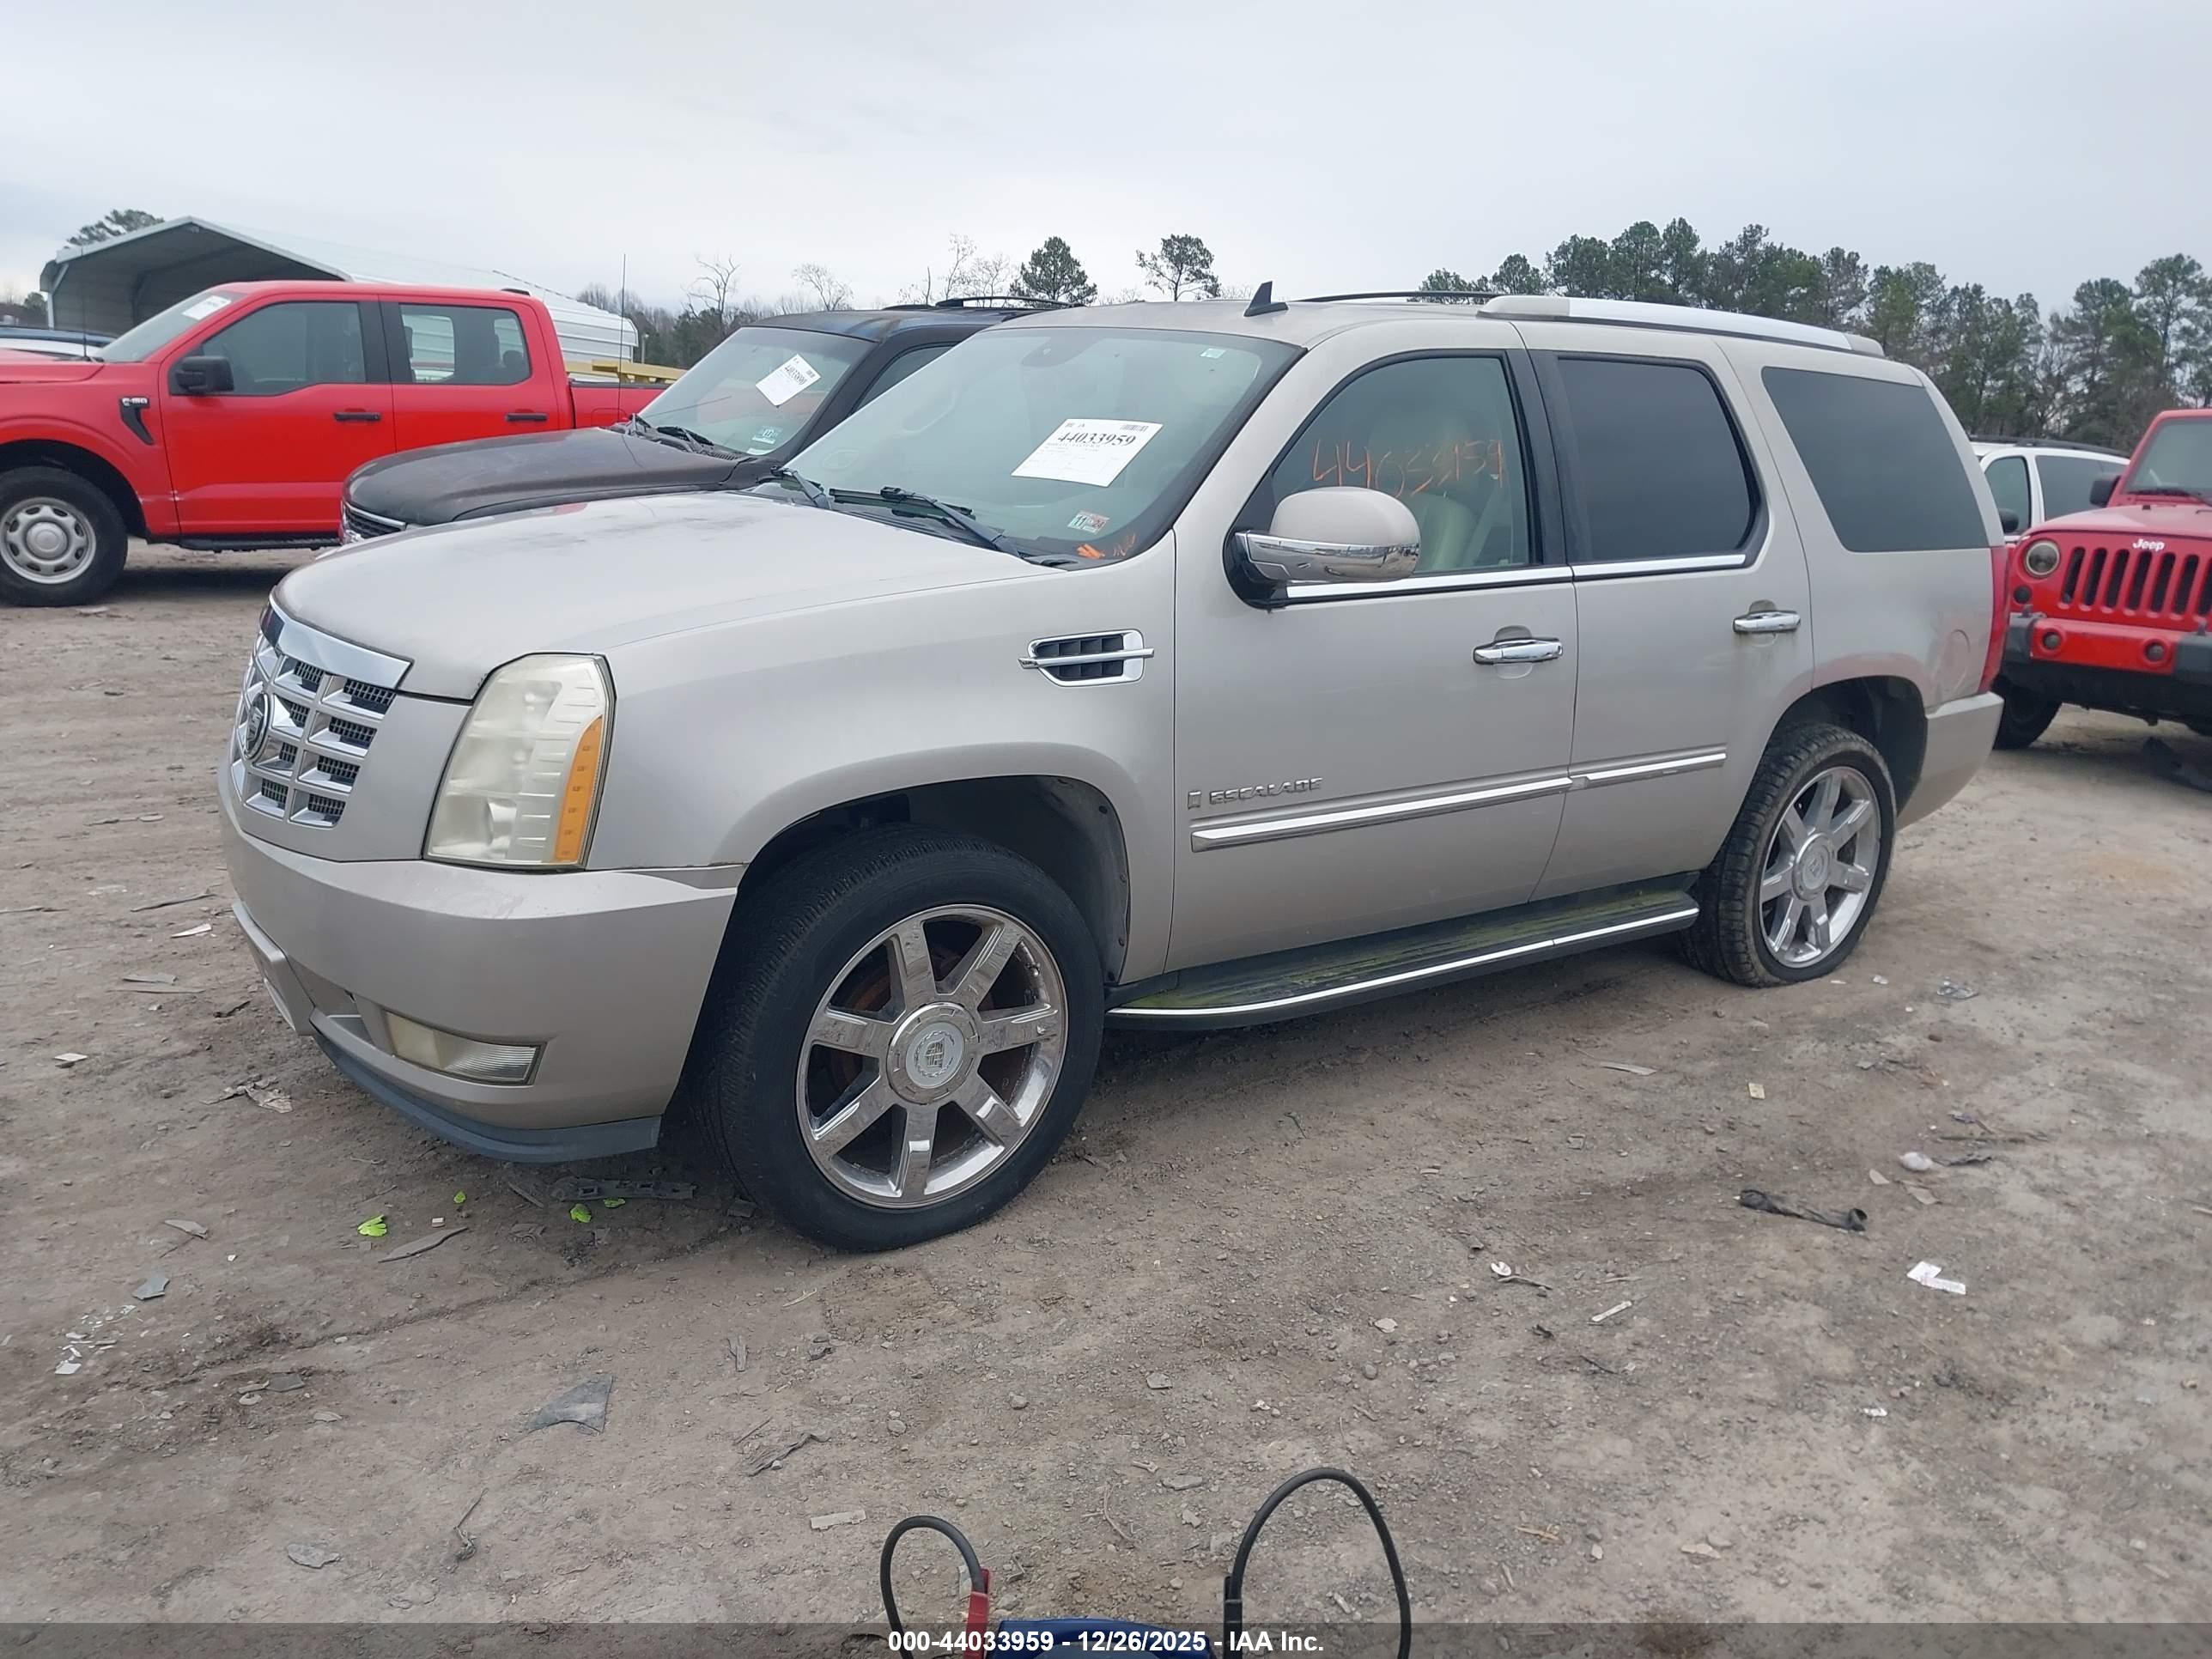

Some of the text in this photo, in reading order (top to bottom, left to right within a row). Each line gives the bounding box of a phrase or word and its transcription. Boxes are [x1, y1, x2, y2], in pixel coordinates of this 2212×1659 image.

[1057, 432, 1137, 447] 44033959
[2132, 538, 2166, 552] Jeep
[1209, 777, 1323, 805] ESCALADE
